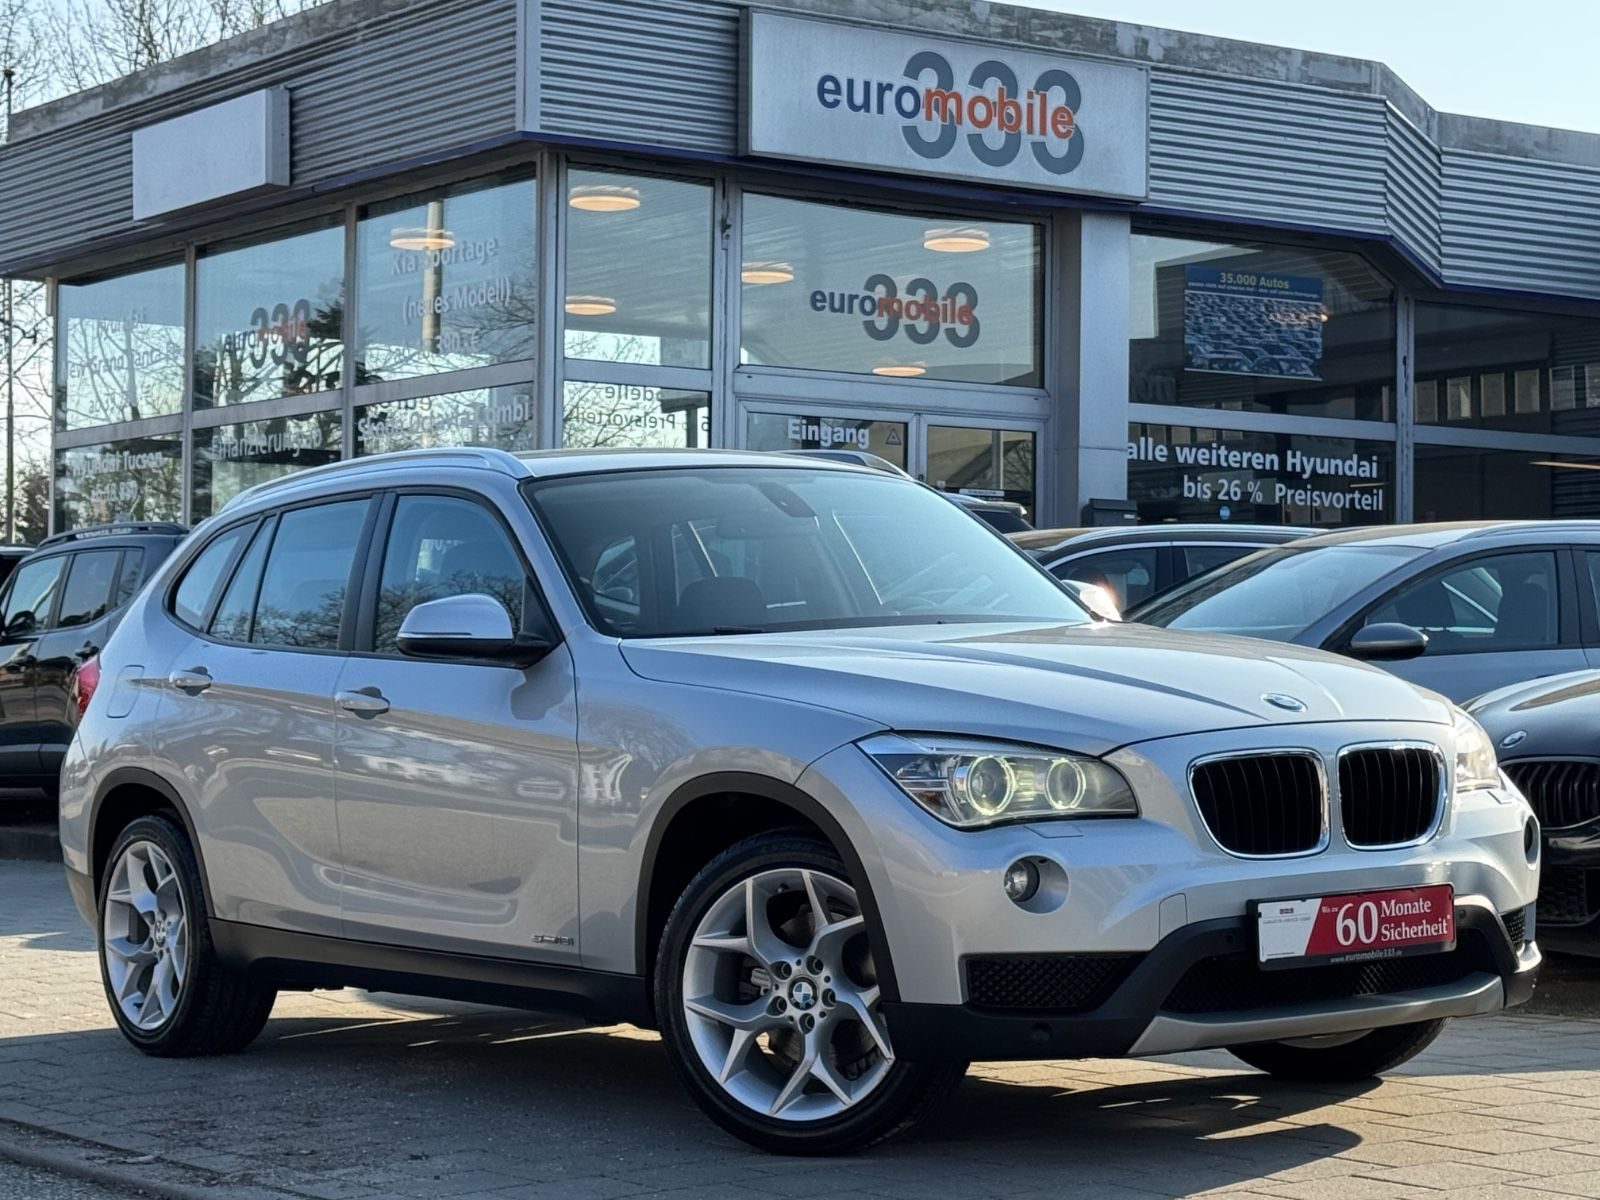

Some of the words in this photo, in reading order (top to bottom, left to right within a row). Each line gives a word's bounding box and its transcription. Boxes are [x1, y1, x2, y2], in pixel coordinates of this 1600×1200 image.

[816, 73, 1075, 140] euromobile
[900, 51, 1084, 175] 333
[422, 238, 496, 269] portage
[453, 276, 511, 310] Modell)
[1219, 272, 1257, 286] 35.000
[1259, 276, 1290, 289] Autos
[809, 289, 975, 326] euromobile
[862, 273, 981, 349] 333
[478, 395, 530, 424] ombi
[787, 418, 870, 449] Eingang
[1127, 437, 1168, 462] alle
[1175, 443, 1279, 472] weiteren
[1286, 449, 1378, 479] Hyundai
[1183, 474, 1212, 499] bis
[1217, 479, 1241, 501] 26
[1247, 481, 1263, 503] %
[1275, 483, 1383, 511] Preisvorteil
[1335, 901, 1379, 947] 60
[1380, 897, 1432, 918] Monate
